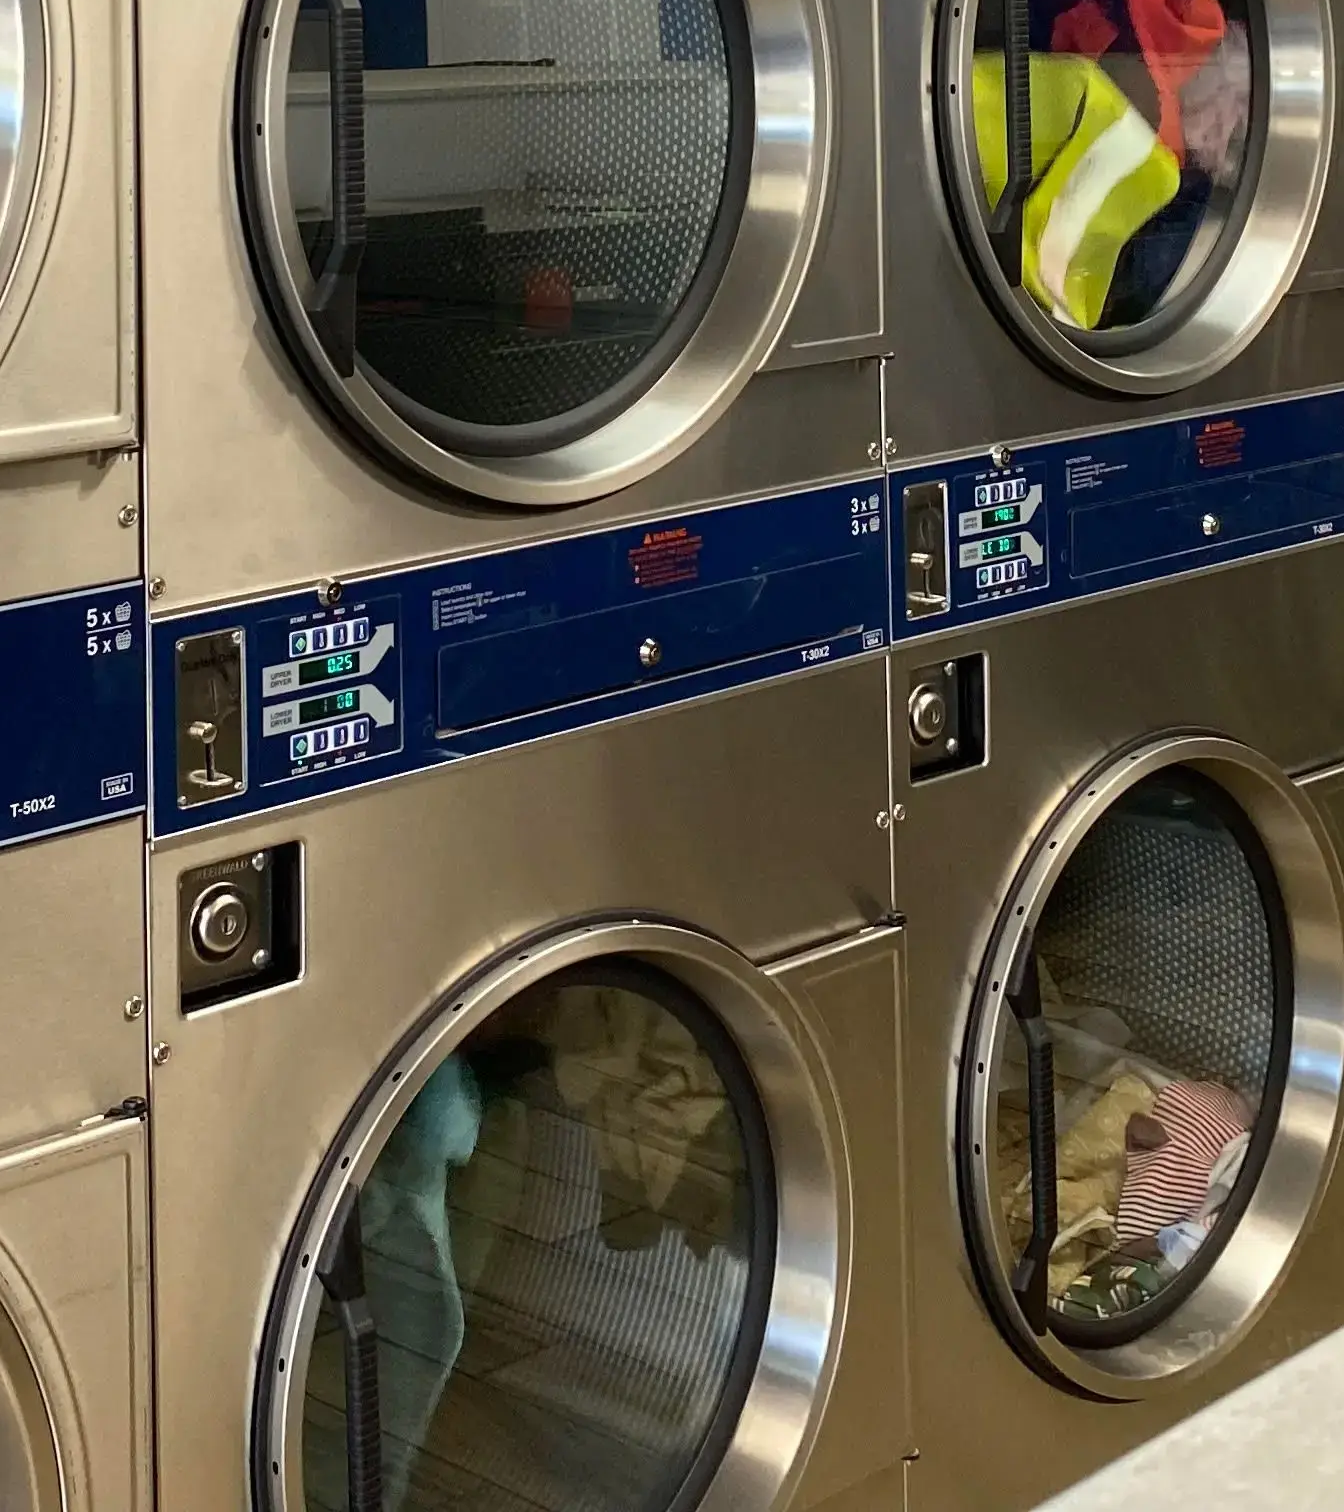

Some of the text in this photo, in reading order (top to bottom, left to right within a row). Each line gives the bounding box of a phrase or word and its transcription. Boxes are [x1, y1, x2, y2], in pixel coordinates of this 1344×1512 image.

[851, 497, 859, 513] 3
[851, 519, 860, 536] 3
[86, 608, 111, 628] 5 x
[86, 636, 112, 656] 5 x
[107, 784, 127, 795] USA
[10, 794, 56, 819] T-50X2
